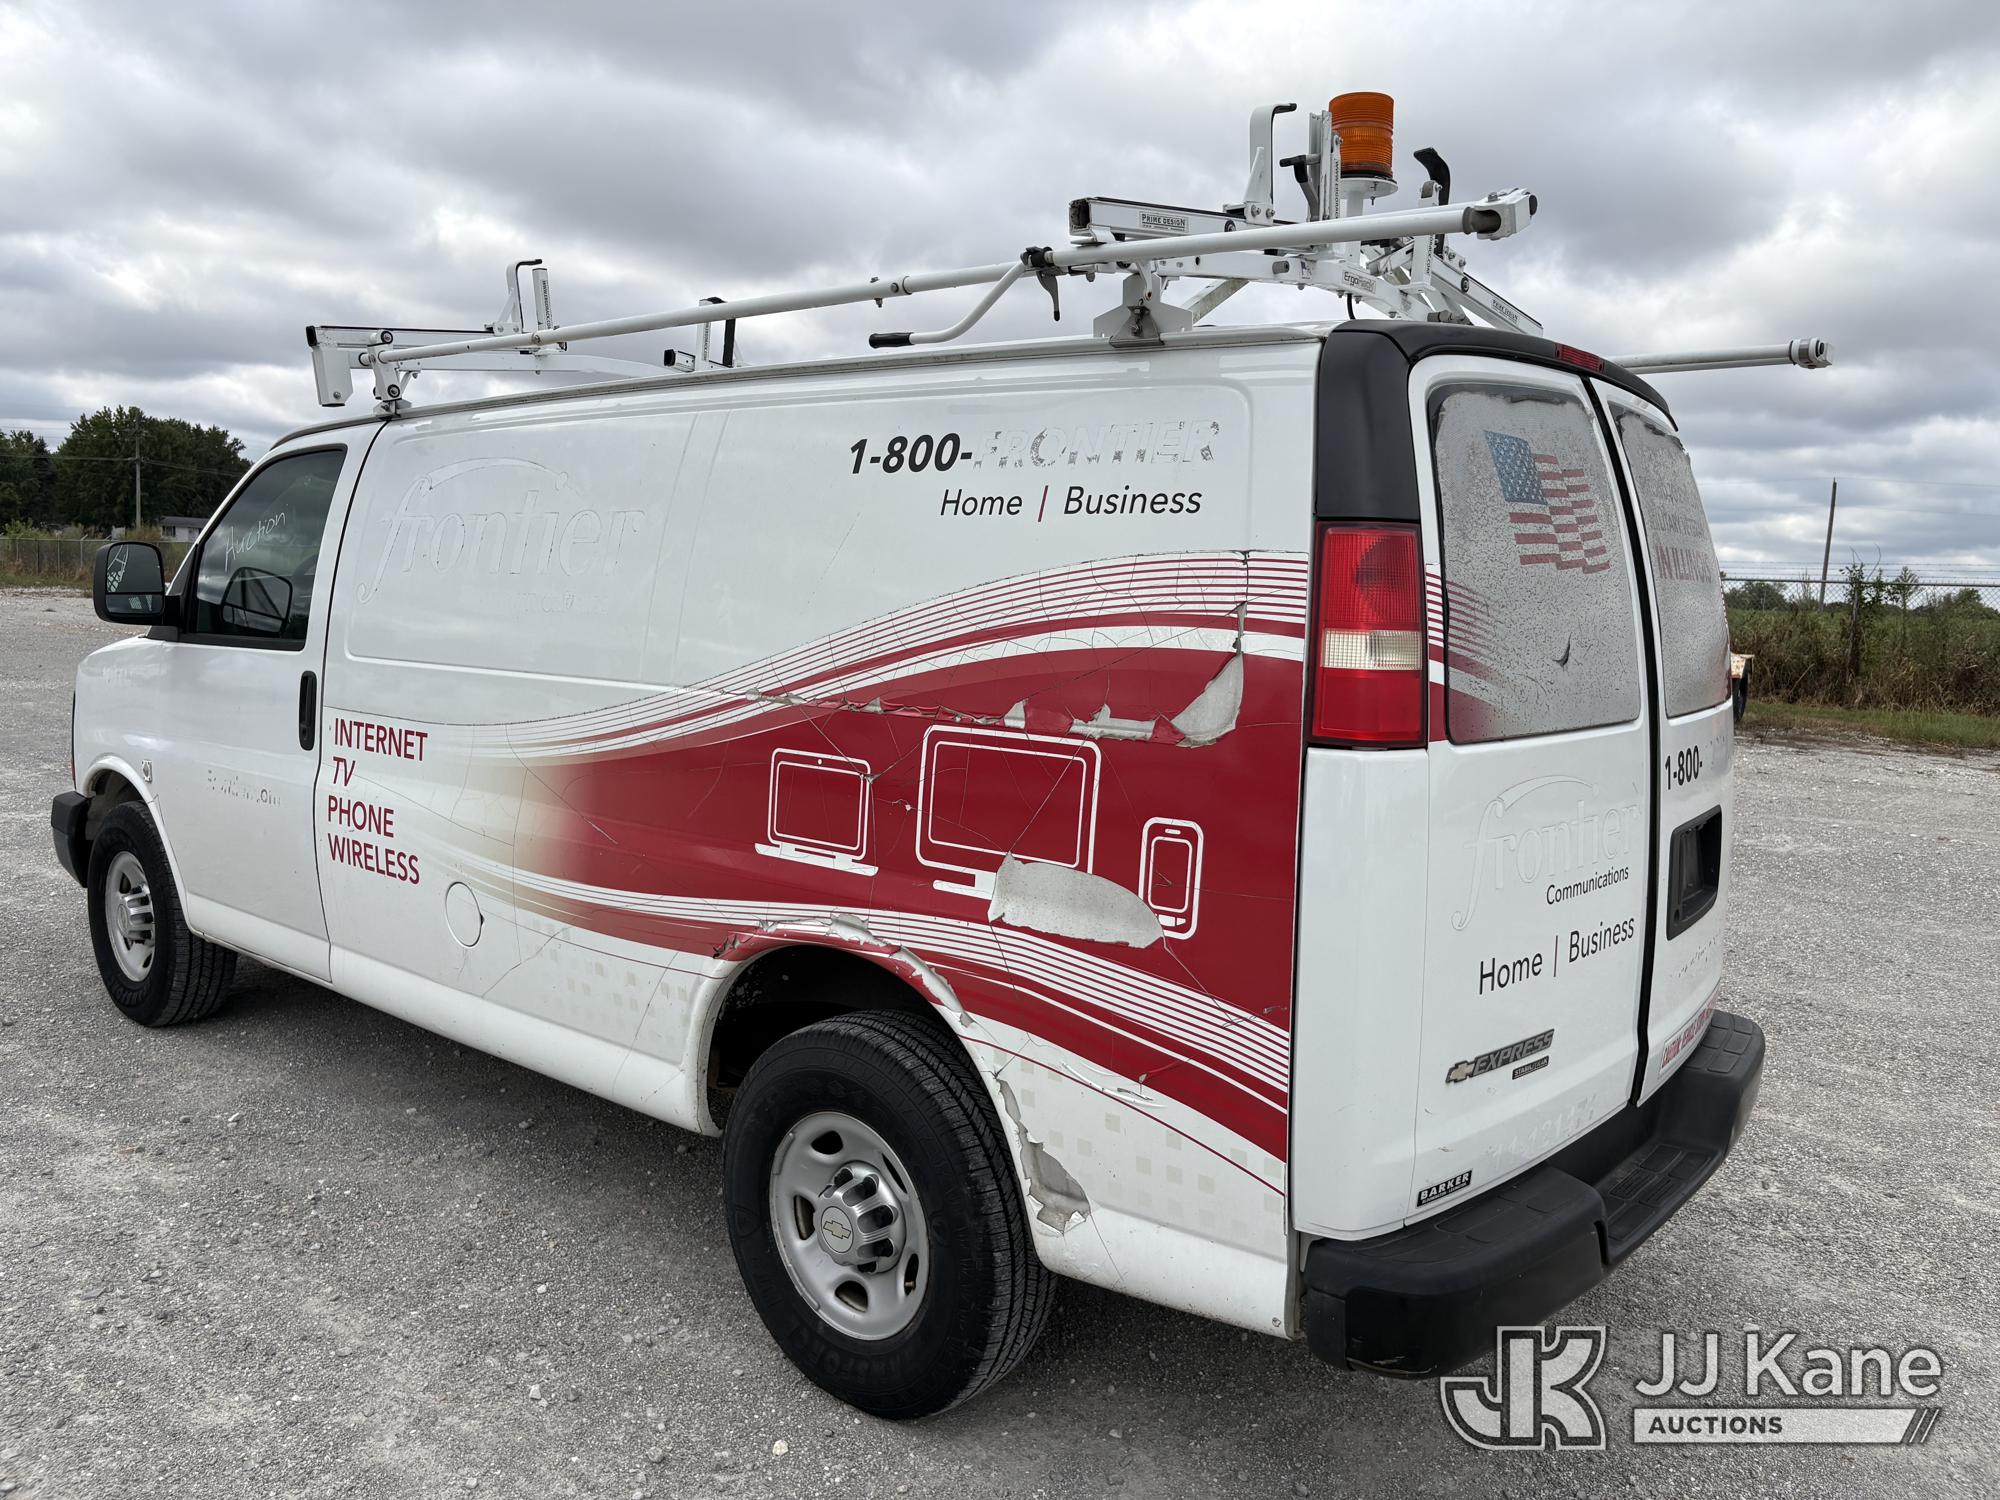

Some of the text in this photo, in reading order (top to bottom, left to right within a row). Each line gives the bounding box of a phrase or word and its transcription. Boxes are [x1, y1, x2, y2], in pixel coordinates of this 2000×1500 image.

[940, 484, 1203, 517] Home Business
[334, 717, 428, 762] INTERNET
[332, 755, 356, 787] TV
[328, 794, 394, 838] PHONE
[327, 832, 421, 885] WIRELESS
[1545, 864, 1630, 905] Communications
[1478, 950, 1544, 996] Home
[1568, 915, 1635, 964] Business
[1471, 1029, 1554, 1078] EXPRESS
[1420, 1172, 1470, 1201] BARKER
